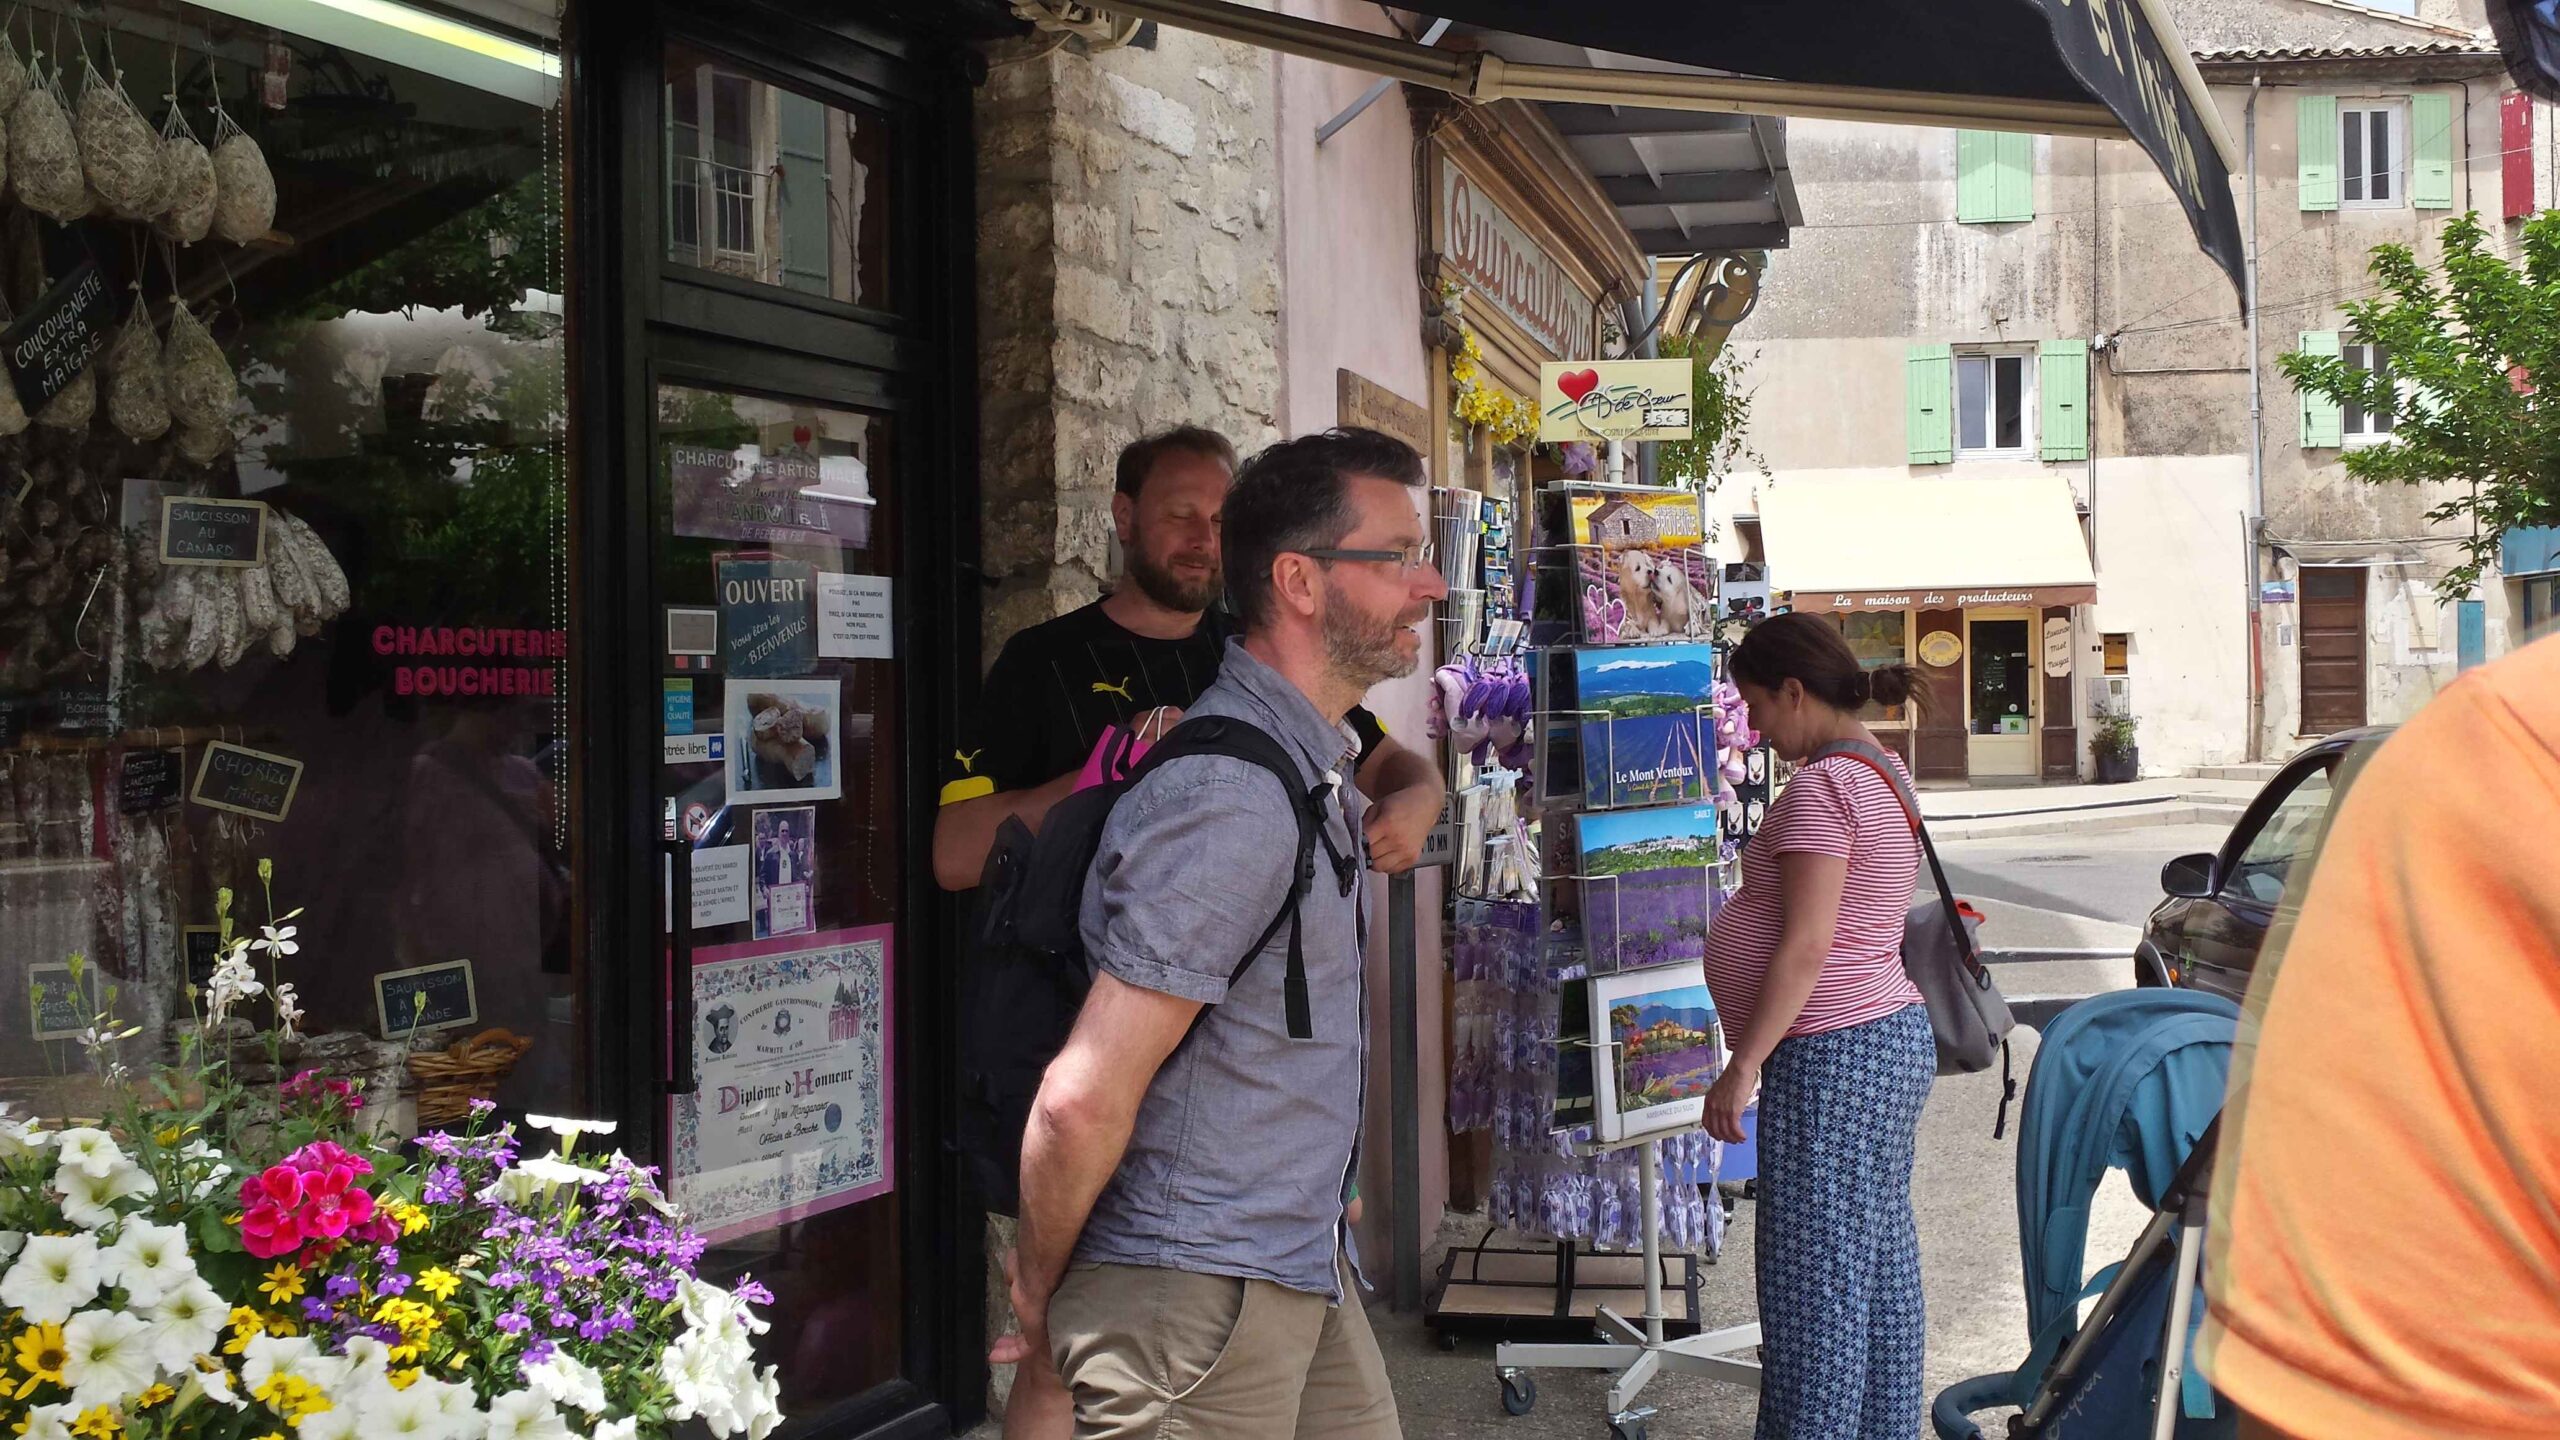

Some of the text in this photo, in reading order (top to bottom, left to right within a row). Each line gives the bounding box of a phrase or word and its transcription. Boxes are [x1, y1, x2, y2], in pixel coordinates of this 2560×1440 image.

[15, 269, 102, 368] COUCOUGNETTE
[44, 320, 87, 370] EXTRA
[1615, 396, 1634, 413] de
[172, 508, 251, 524] SAUCISSON
[1655, 515, 1697, 536] PROVENCE
[198, 526, 216, 539] AU
[176, 540, 234, 556] CANARD
[726, 579, 806, 605] OUVERT
[1833, 590, 2034, 607] La maison des producteurs
[372, 625, 567, 657] CHARCUTERIE
[747, 616, 808, 664] BIENVENUS
[395, 666, 555, 696] BOUCHERIE
[688, 741, 707, 755] libre
[1615, 771, 1627, 784] Le
[1629, 769, 1655, 783] Mont
[1656, 766, 1694, 779] Ventoux
[1694, 809, 1711, 819] SAULT
[1426, 833, 1448, 853] 10 MN
[386, 973, 462, 997] SAUCISSON
